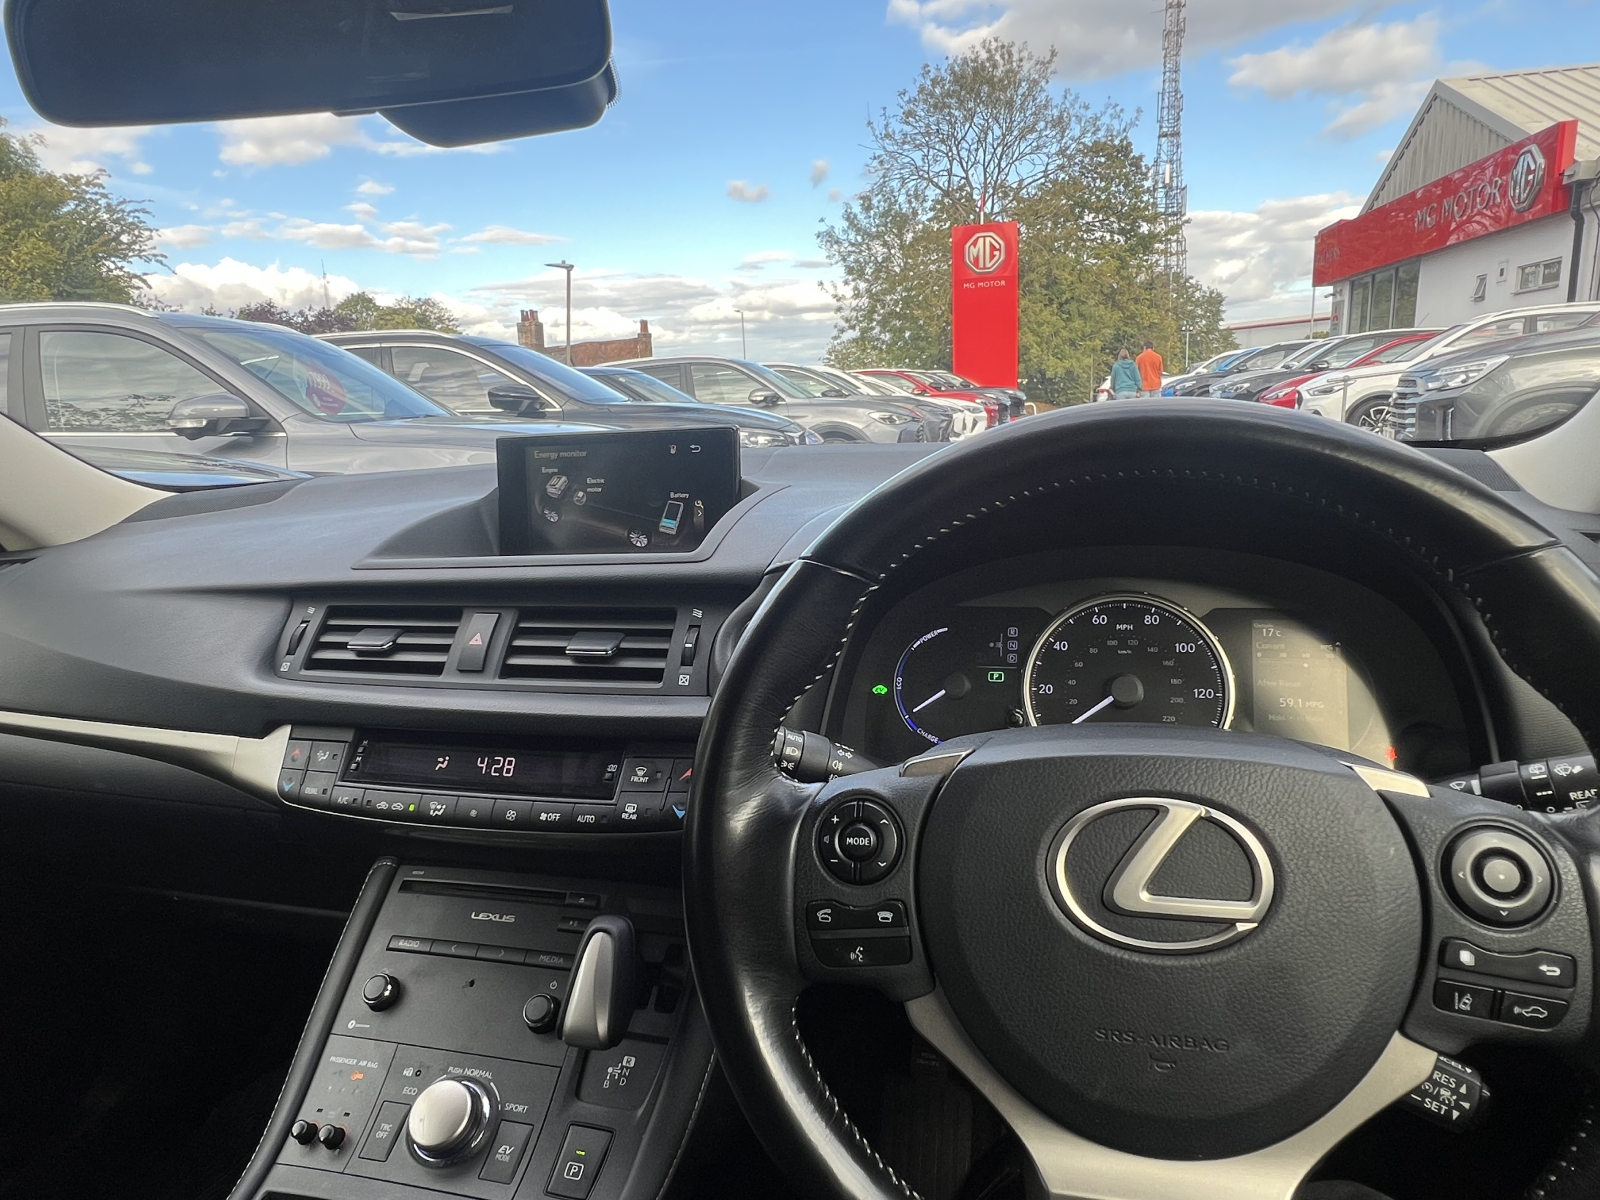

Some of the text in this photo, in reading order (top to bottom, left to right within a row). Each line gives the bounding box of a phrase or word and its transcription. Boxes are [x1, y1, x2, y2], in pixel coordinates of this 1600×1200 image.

[1414, 177, 1502, 233] MG MOTOR
[967, 235, 1002, 270] MG
[963, 280, 1006, 290] MG MOTOR
[534, 450, 587, 460] Energy monitor
[541, 466, 559, 474] Engine
[670, 491, 690, 499] Battery
[1092, 615, 1108, 625] 60
[1144, 615, 1160, 625] 80
[1115, 623, 1134, 631] MPH
[919, 629, 939, 644] POWER
[1053, 641, 1068, 651] 40
[1174, 643, 1196, 653] 100
[1038, 684, 1054, 694] 20
[1193, 688, 1215, 699] 120
[1279, 697, 1303, 708] 59.1
[786, 733, 803, 743] AUTO
[916, 727, 939, 744] CHARGE
[476, 756, 516, 777] 4:28
[304, 786, 318, 795] DUAL
[337, 796, 349, 804] A/C
[546, 813, 562, 822] OFF
[576, 814, 596, 823] AUTO
[621, 812, 638, 820] REAR
[846, 837, 871, 846] MODE
[470, 911, 516, 923] LEXUS
[398, 939, 420, 948] RADIO
[538, 954, 564, 964] MEDIA
[329, 1055, 358, 1066] PASSENGER
[625, 1057, 634, 1066] R
[447, 1066, 493, 1079] PUSH NORMAL
[621, 1068, 630, 1076] N
[603, 1079, 610, 1088] B
[619, 1077, 627, 1086] D
[1432, 1070, 1457, 1088] RES
[402, 1086, 418, 1096] ECO
[504, 1102, 529, 1114] SPORT
[1423, 1097, 1449, 1115] SET
[379, 1123, 393, 1132] TRC
[375, 1131, 389, 1139] OFF
[498, 1145, 515, 1155] EV
[495, 1154, 511, 1163] MODE
